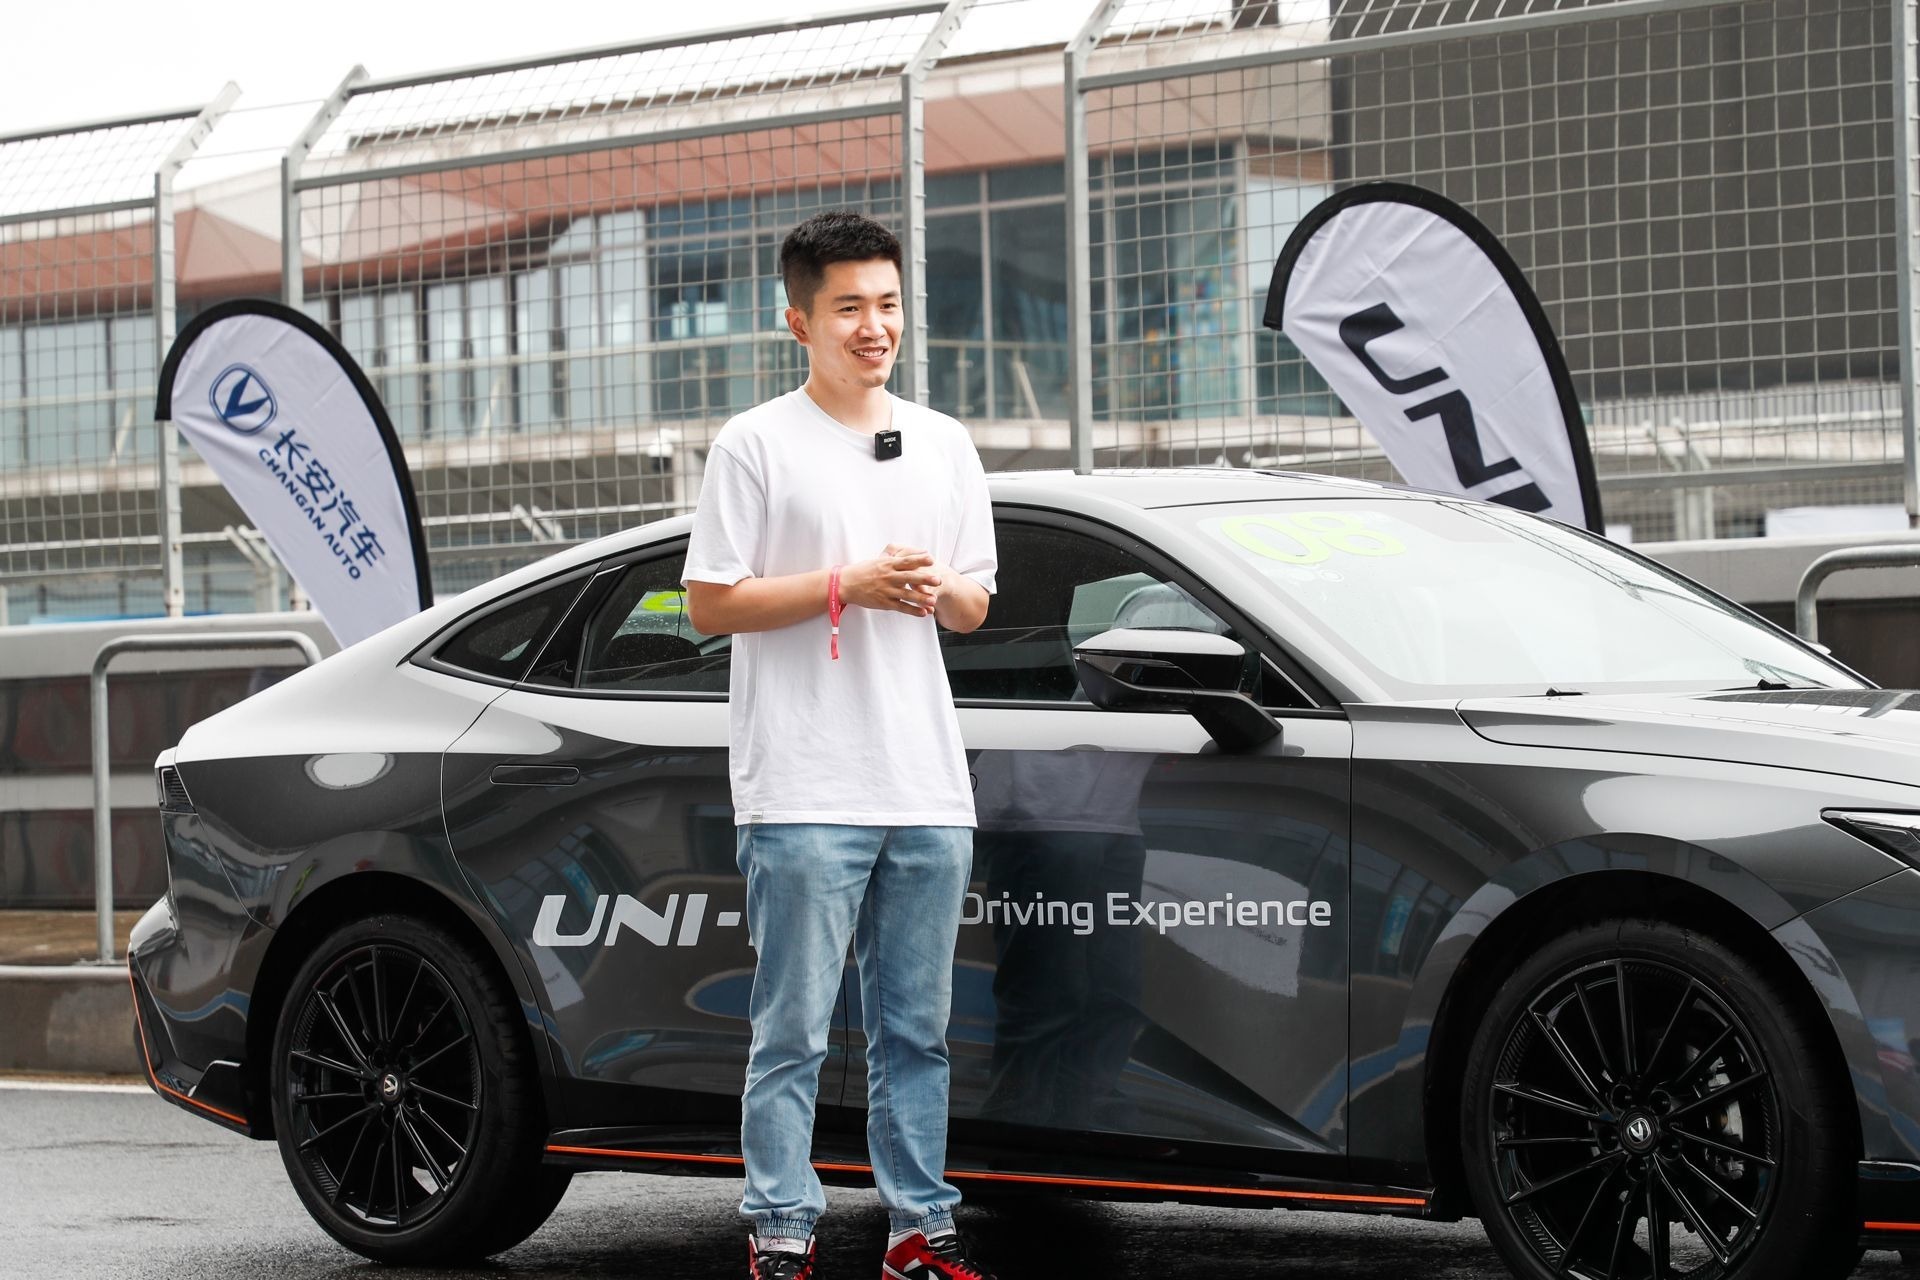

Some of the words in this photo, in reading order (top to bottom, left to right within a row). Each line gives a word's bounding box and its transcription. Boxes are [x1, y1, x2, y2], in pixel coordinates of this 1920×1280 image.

[259, 448, 325, 531] CHANGAN
[323, 534, 361, 580] AUTO
[274, 429, 385, 567] 长安汽车
[1221, 511, 1408, 565] 08
[532, 893, 756, 947] UNI-
[959, 892, 1094, 935] Driving
[1106, 892, 1332, 935] Experience
